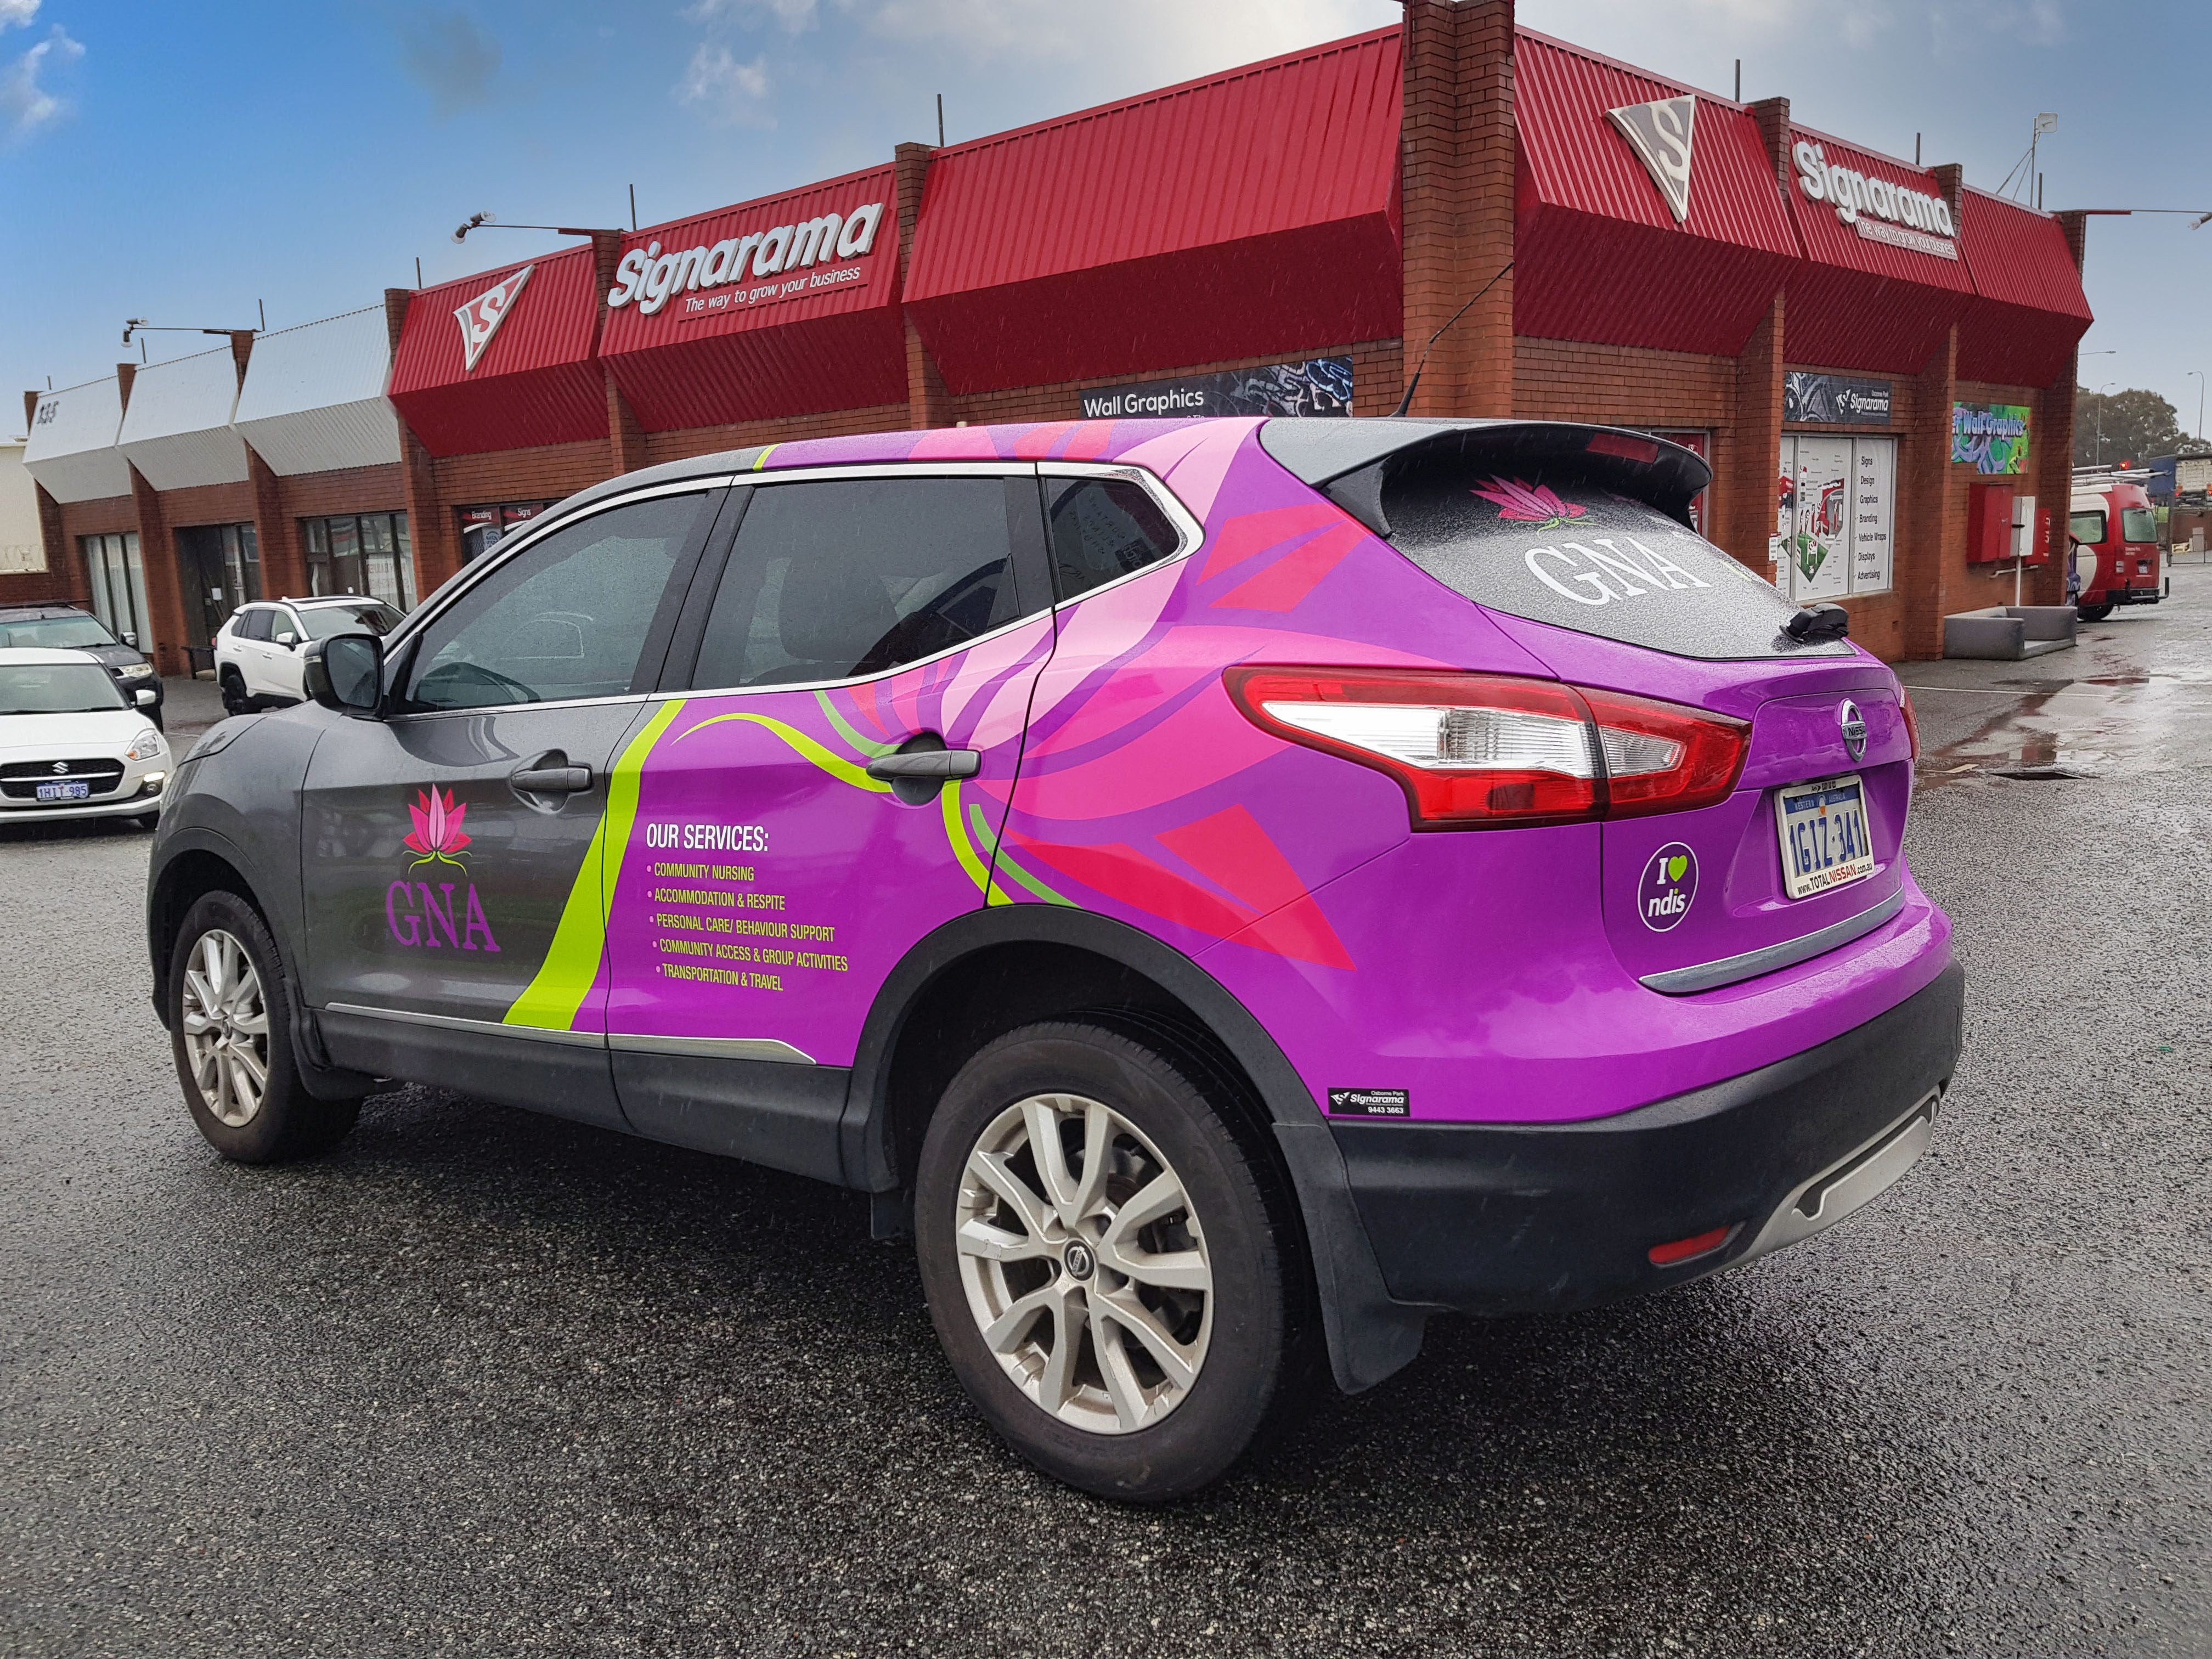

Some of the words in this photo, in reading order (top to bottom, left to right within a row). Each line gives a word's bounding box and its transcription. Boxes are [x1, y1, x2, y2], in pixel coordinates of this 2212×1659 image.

[1792, 141, 1955, 238] Signarama
[1873, 224, 1889, 242] way
[607, 202, 884, 315] Signarama
[686, 297, 704, 313] The
[708, 295, 730, 309] way
[735, 290, 746, 303] to
[749, 284, 777, 304] grow
[779, 278, 808, 298] your
[810, 267, 860, 289] business
[1084, 396, 1120, 417] Wall
[1125, 388, 1204, 415] Graphics
[1850, 393, 1888, 414] Signarama
[1985, 413, 2024, 440] Graphics
[1525, 537, 1712, 605] GNA
[646, 823, 679, 849] OUR
[684, 825, 769, 851] SERVICES:
[654, 862, 710, 878] COMMUNITY
[712, 865, 754, 881] NURSING
[1656, 857, 1669, 885] I
[654, 888, 735, 907] ACCOMMODATION
[737, 893, 745, 908] &
[747, 893, 786, 911] RESPITE
[1647, 888, 1686, 917] ndis
[386, 880, 501, 952] GNA
[656, 913, 704, 931] PERSONAL
[706, 917, 733, 934] CARE/
[736, 919, 788, 938] BEHAVIOUR
[790, 924, 835, 943] SUPPORT
[659, 938, 714, 957] COMMUNITY
[715, 944, 751, 962] ACCESS
[753, 947, 760, 962] &
[763, 949, 794, 966] GROUP
[796, 952, 849, 972] ACTIVITIES
[662, 963, 738, 985] TRANSPORTATION
[741, 972, 748, 986] &
[749, 973, 783, 991] TRAVEL
[1350, 1094, 1404, 1104] Signarama
